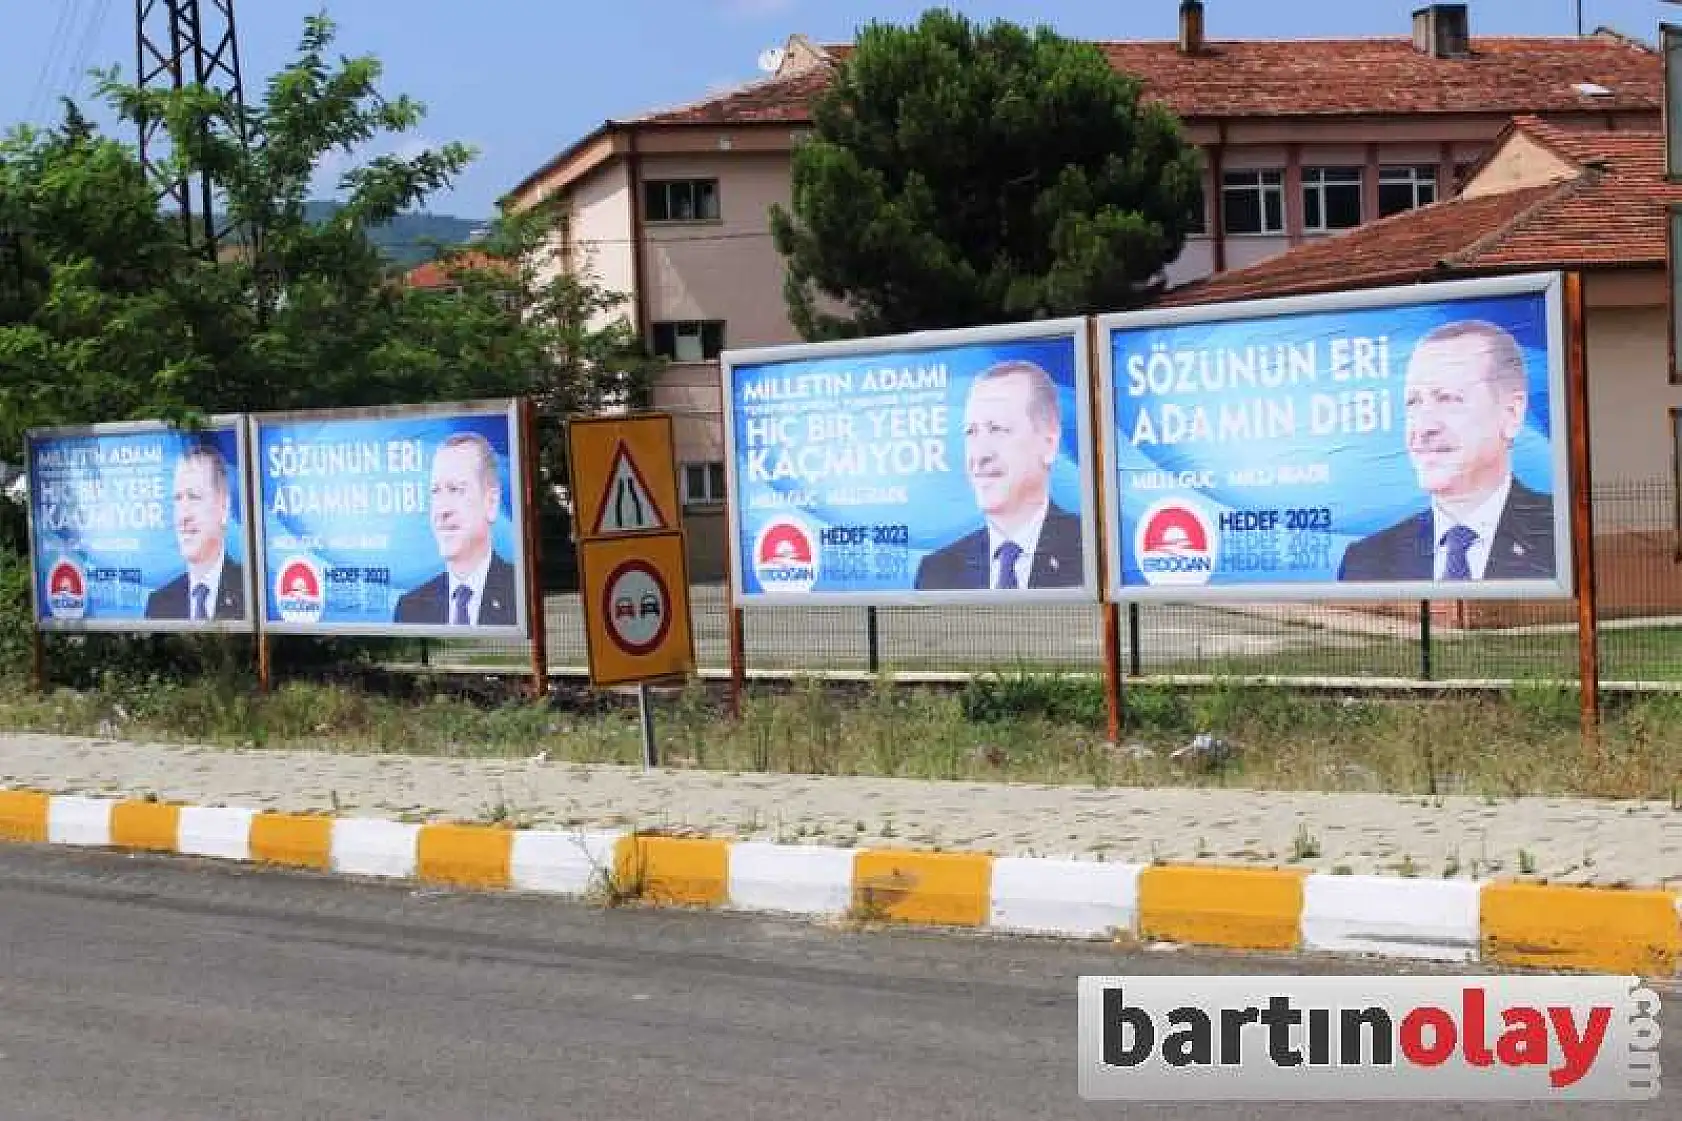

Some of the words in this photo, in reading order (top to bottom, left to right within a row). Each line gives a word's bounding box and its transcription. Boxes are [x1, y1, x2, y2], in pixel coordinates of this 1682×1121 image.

[868, 405, 949, 439] YERE
[1132, 397, 1294, 445] ADAMIN
[1218, 511, 1279, 531] HEDEF
[1284, 508, 1332, 531] 2023
[820, 526, 868, 546] HEDEF
[872, 525, 910, 545] 2023
